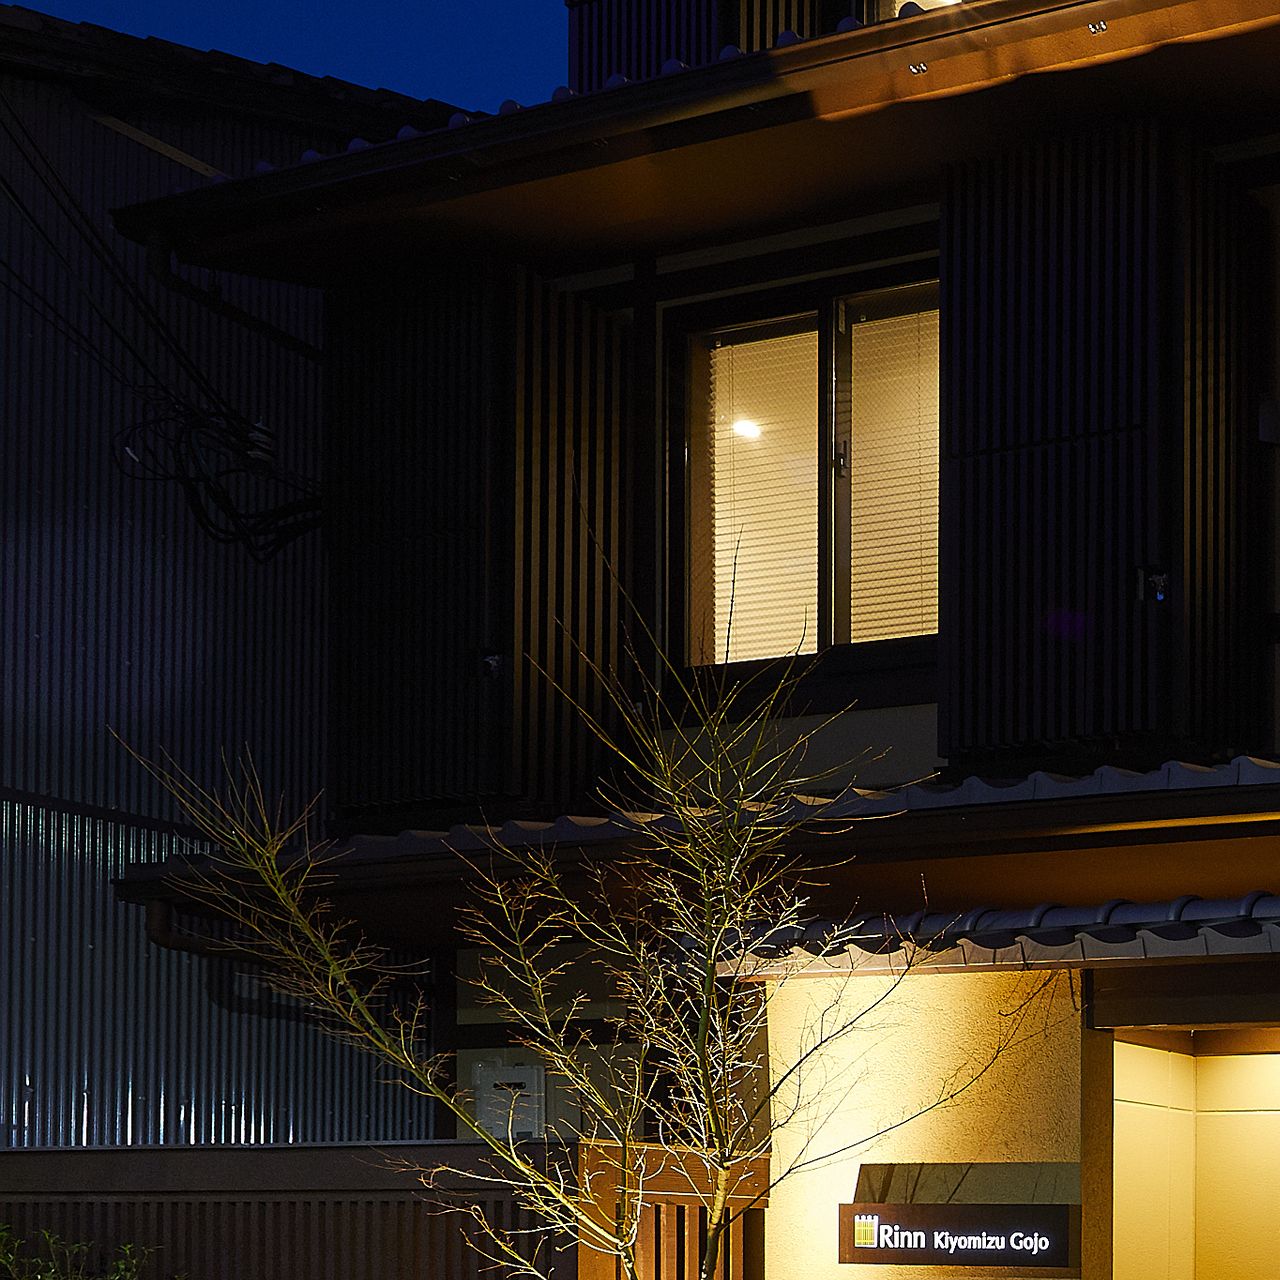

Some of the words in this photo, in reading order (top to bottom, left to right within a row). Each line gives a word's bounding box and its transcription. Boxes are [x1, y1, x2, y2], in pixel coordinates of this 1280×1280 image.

[879, 1224, 926, 1250] Rinn
[933, 1231, 1005, 1254] Kiyomizu
[1009, 1232, 1050, 1255] Gojo
